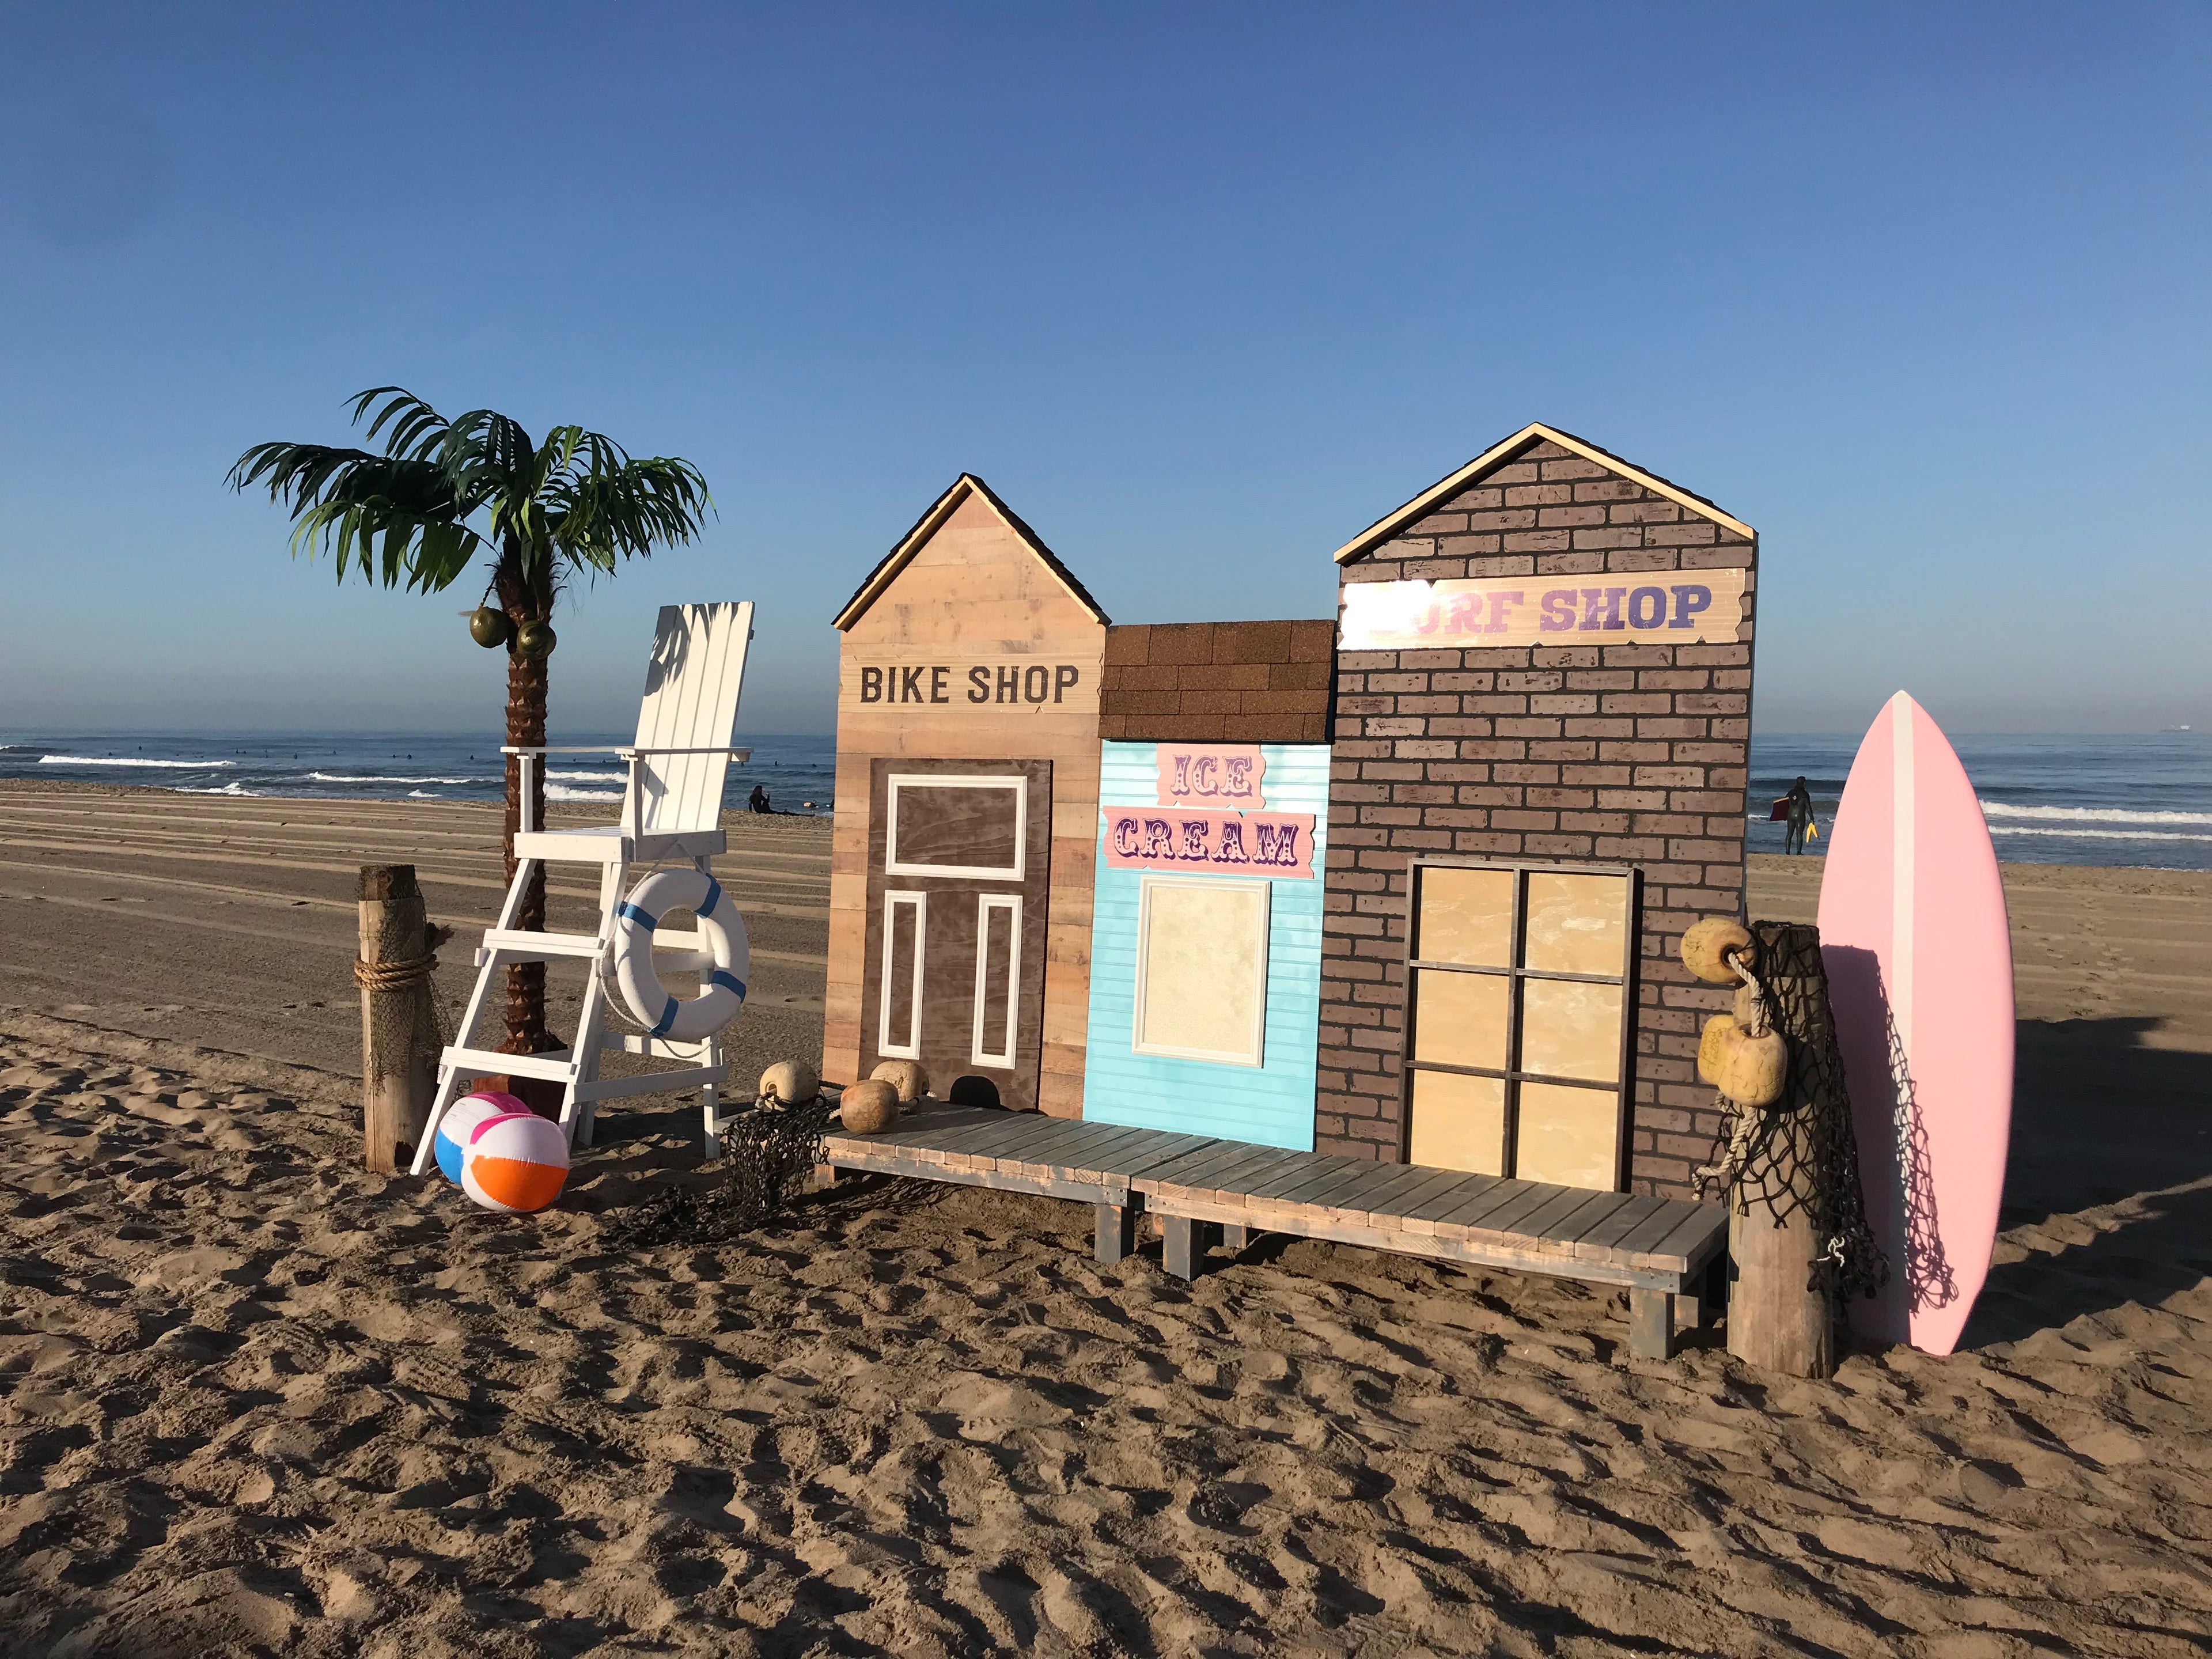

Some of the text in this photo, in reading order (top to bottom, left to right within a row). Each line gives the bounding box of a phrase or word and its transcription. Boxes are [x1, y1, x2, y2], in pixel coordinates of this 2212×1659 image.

[1370, 585, 1711, 634] URF SHOP
[861, 665, 1078, 703] BIKE SHOP
[1171, 754, 1253, 797] ICE
[1113, 816, 1299, 866] CREAM
